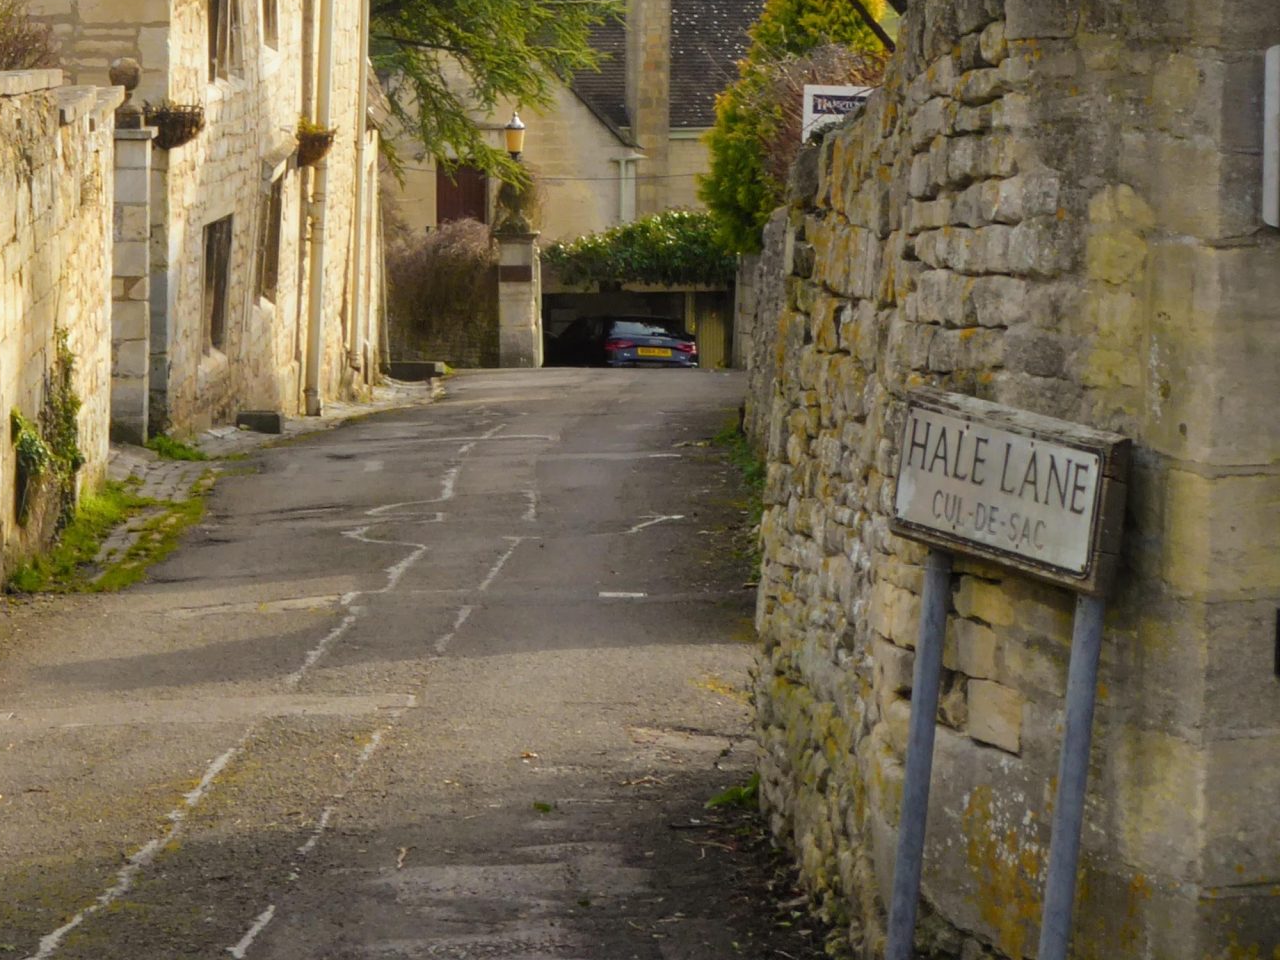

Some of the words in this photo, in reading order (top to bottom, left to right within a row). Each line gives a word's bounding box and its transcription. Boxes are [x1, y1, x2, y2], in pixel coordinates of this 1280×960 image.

[907, 418, 989, 486] HALE
[999, 442, 1089, 515] LANE
[932, 489, 1048, 550] CUL-DE-SAC
